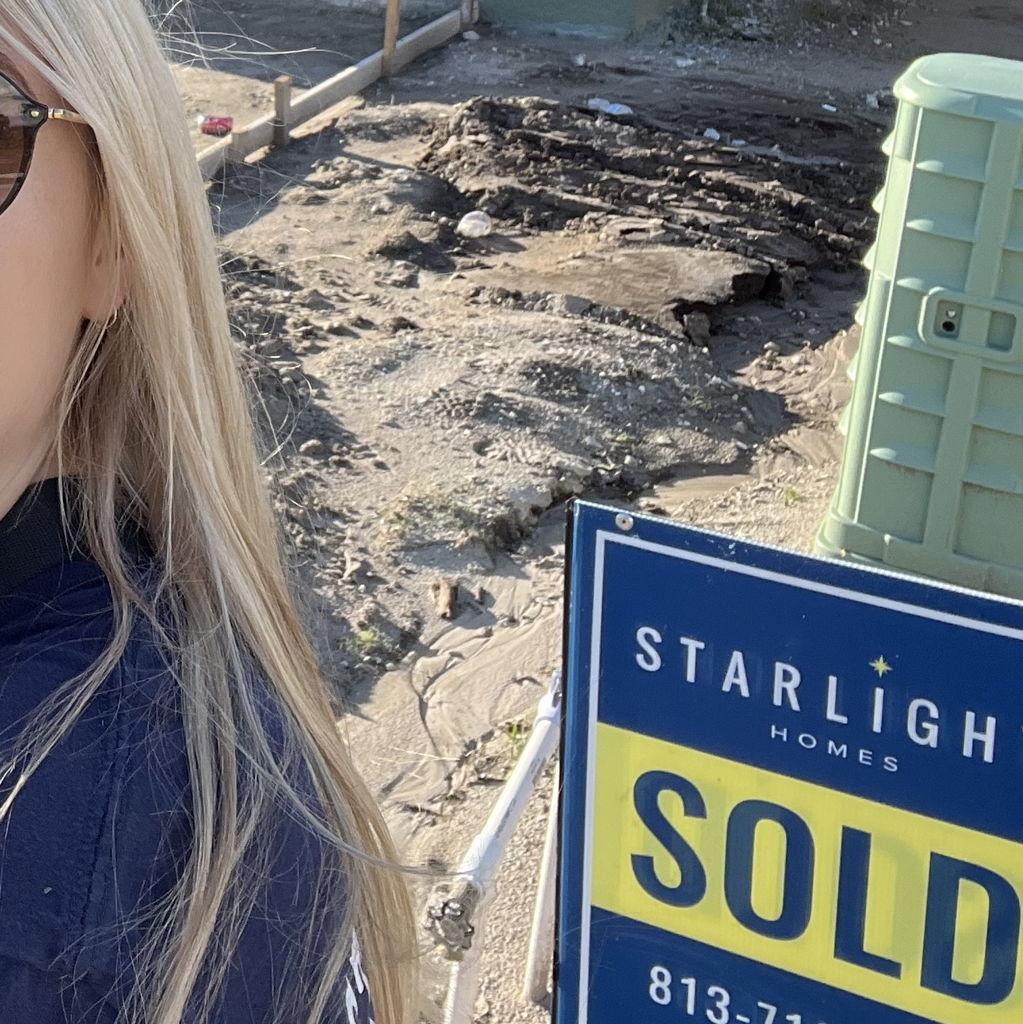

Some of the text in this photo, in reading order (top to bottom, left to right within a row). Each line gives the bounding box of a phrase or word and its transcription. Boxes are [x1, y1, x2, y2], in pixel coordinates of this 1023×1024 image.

[635, 626, 1023, 764] STARLIGH
[771, 724, 899, 772] HOMES
[630, 770, 1022, 1006] SOLD
[649, 965, 827, 1024] 813-7
